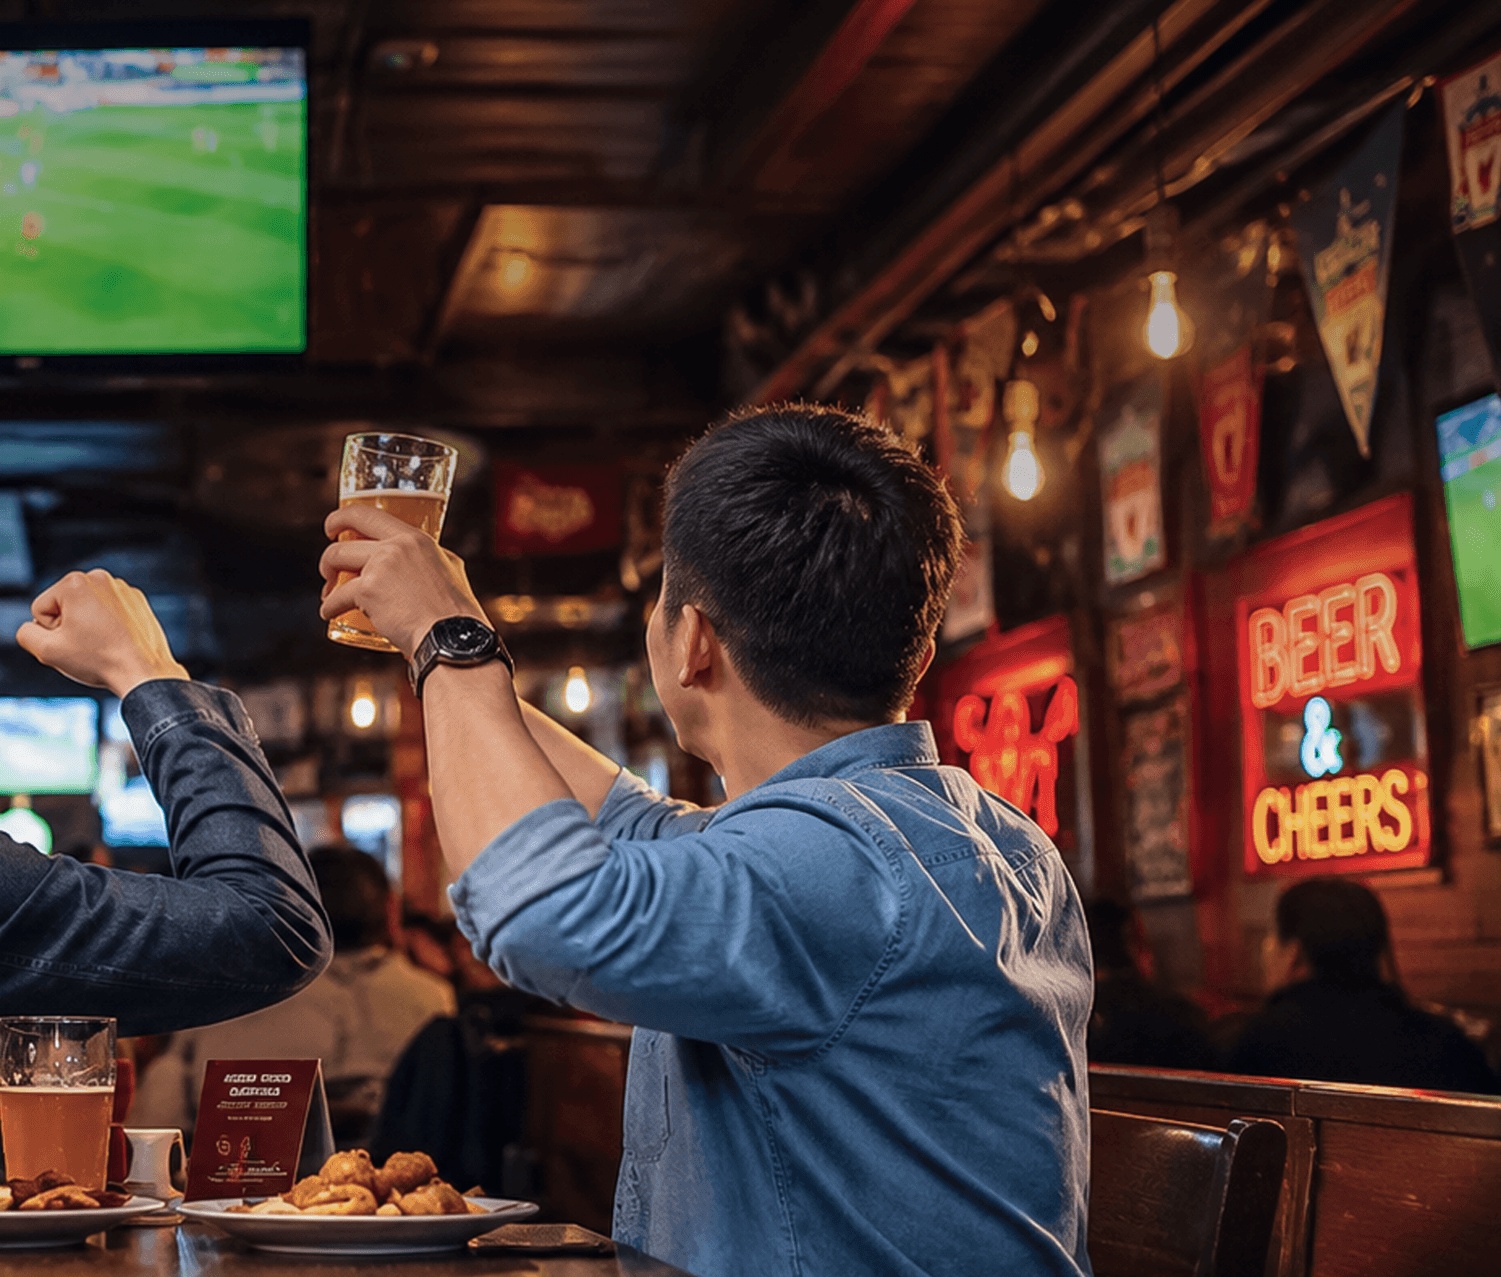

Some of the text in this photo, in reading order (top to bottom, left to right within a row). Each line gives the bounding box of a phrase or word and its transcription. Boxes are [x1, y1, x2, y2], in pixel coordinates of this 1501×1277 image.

[1249, 573, 1401, 709] BEER
[1300, 696, 1343, 778] &
[1253, 769, 1412, 865] CHEERS
